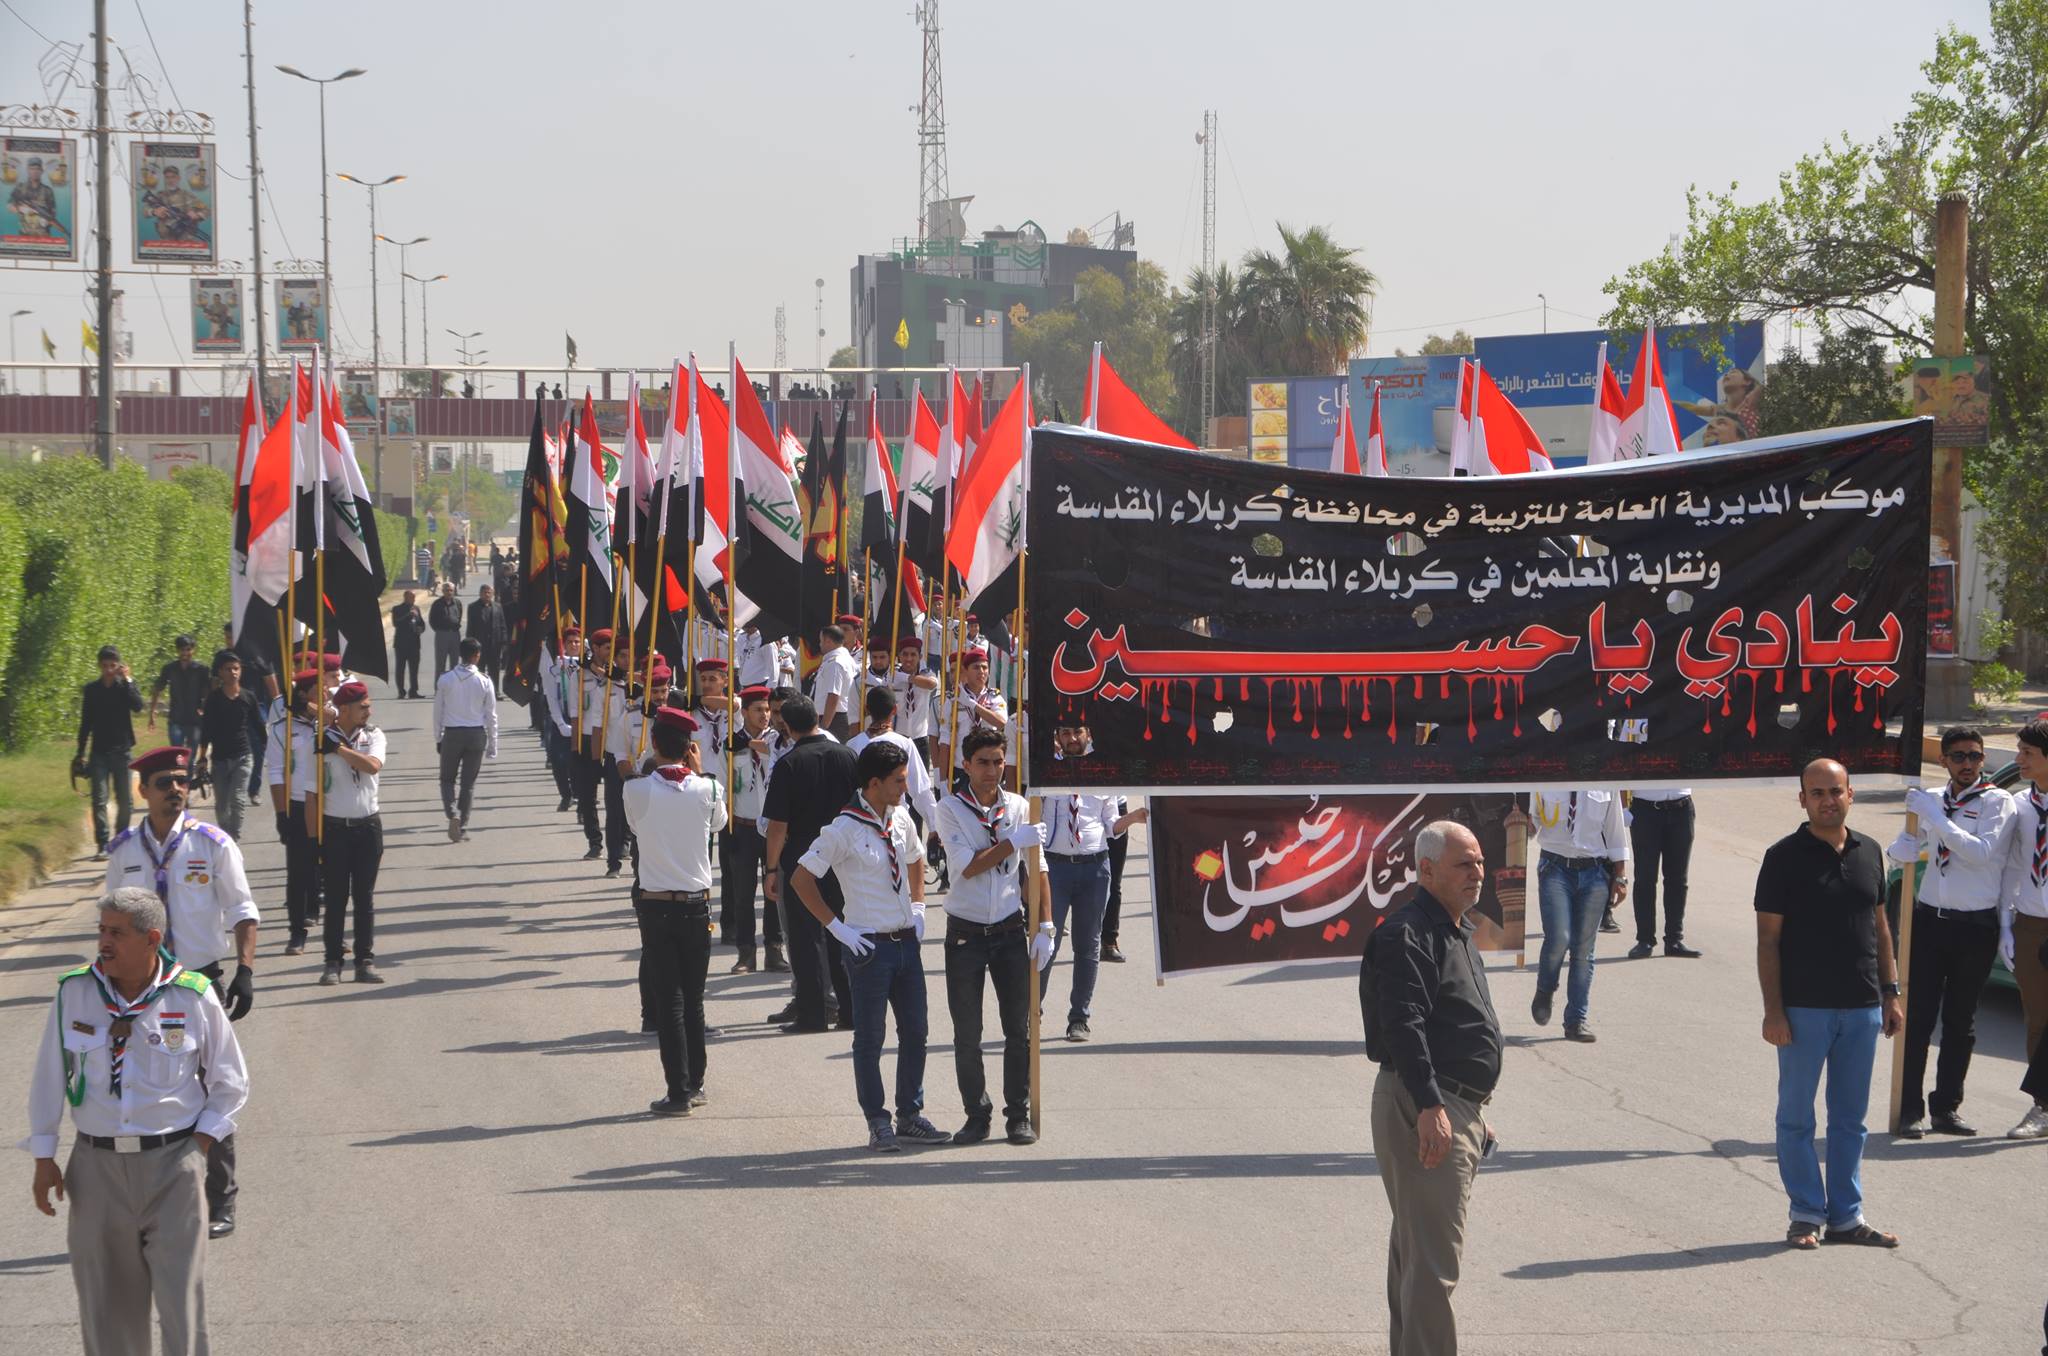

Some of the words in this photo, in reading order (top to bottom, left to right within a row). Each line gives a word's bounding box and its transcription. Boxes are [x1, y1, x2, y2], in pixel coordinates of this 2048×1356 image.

[1056, 484, 1163, 521] المقدسة
[1170, 488, 1283, 530] كربلاء
[1291, 497, 1416, 528] محافظة
[1468, 502, 1568, 533] للتربية
[1574, 494, 1666, 523] العامة
[1676, 484, 1791, 526] المديرية
[1798, 477, 1905, 520] موكب
[1423, 502, 1459, 538] في
[1230, 555, 1337, 592] المقدسة
[1344, 557, 1459, 600] كربلاء
[1468, 556, 1502, 603] في
[1511, 552, 1619, 599] المعلمين
[1628, 550, 1721, 594] ونقابة
[1675, 592, 1904, 700] ينادي
